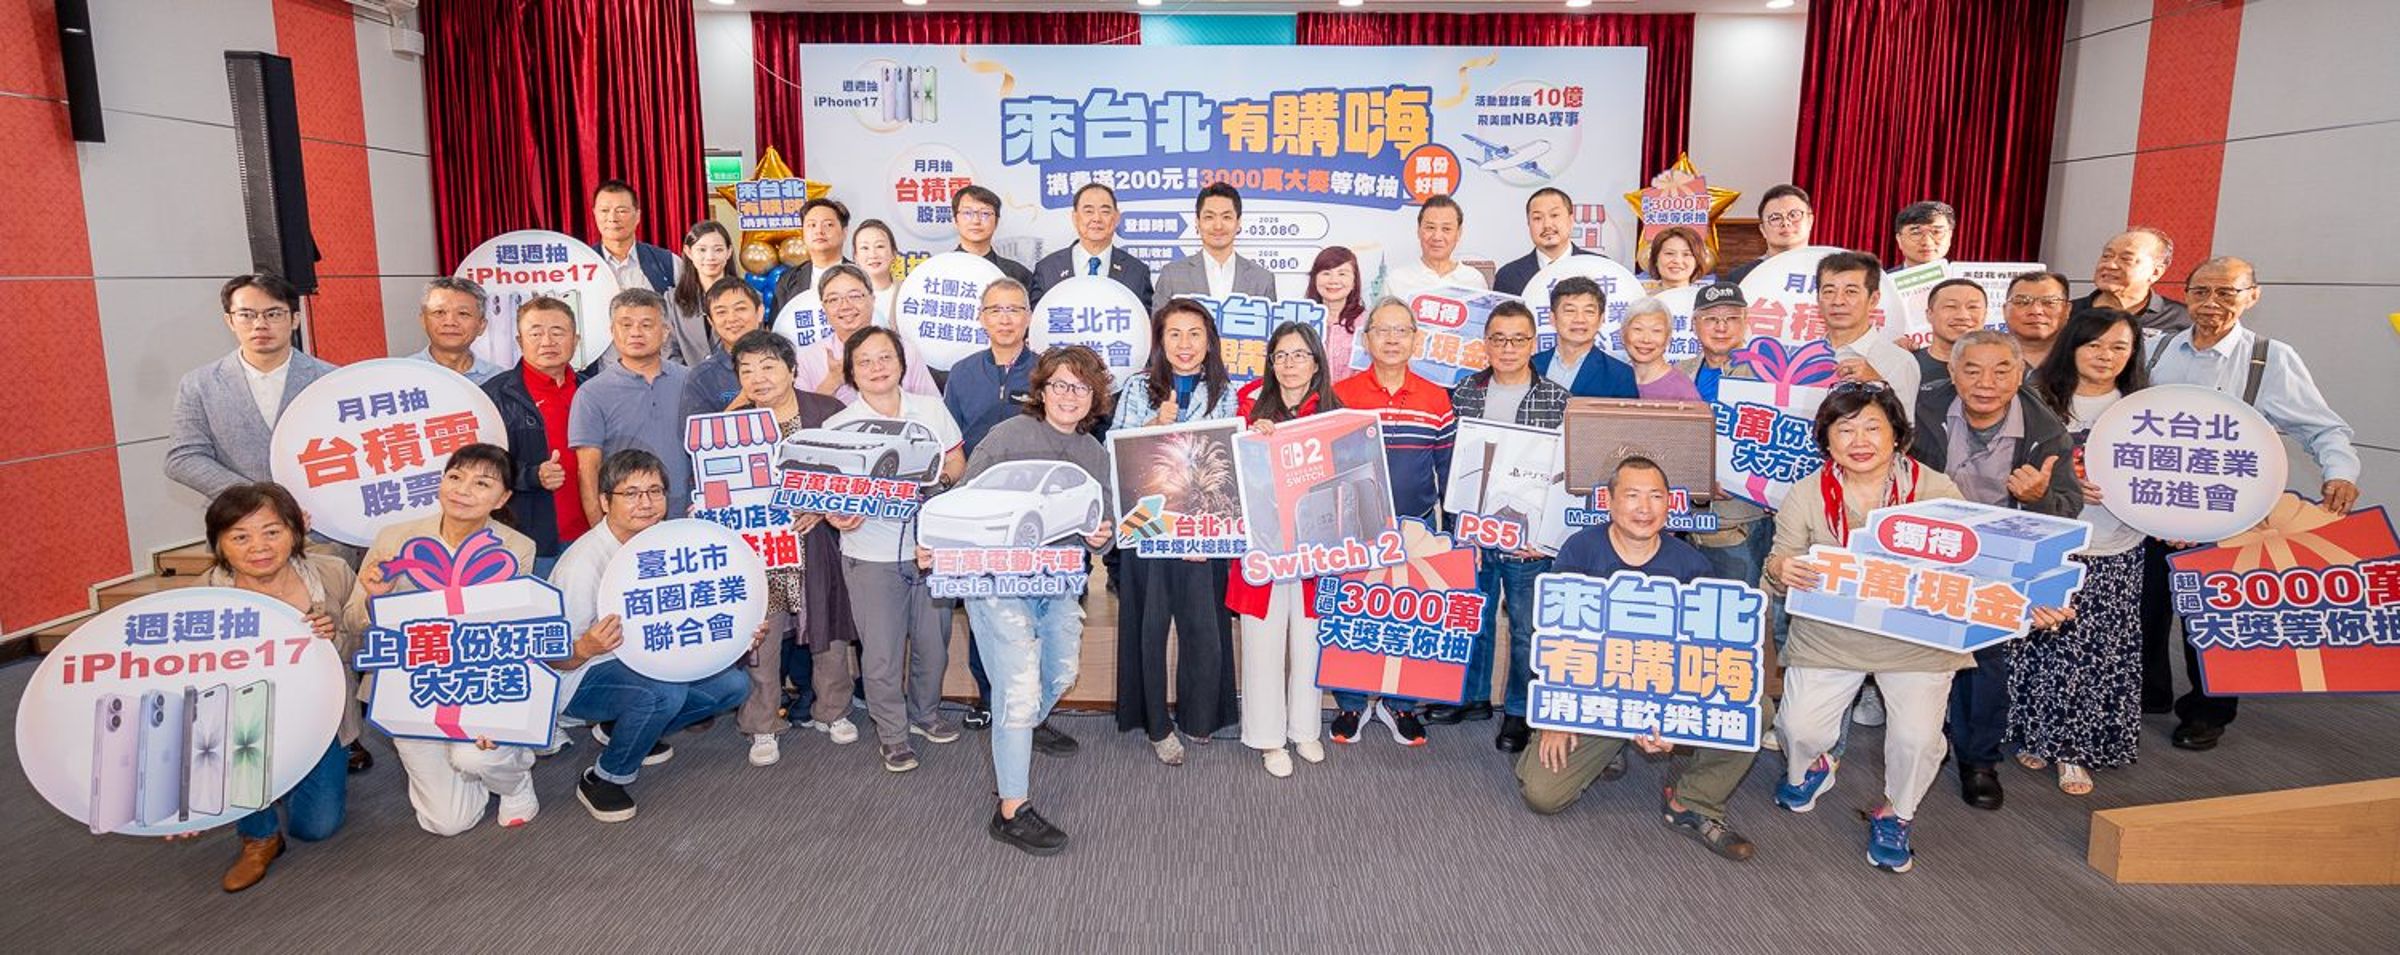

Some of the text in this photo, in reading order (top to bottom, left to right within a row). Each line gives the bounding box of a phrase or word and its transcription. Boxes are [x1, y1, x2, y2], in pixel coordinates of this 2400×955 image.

[813, 95, 879, 108] iPhone17
[914, 159, 953, 173] 月月抽
[738, 180, 804, 199] 來台北
[916, 205, 954, 225] 股票
[496, 243, 569, 265] 週週抽
[467, 264, 598, 285] iPhone17
[923, 276, 979, 300] 社團法
[902, 296, 982, 321] 台灣連鎖
[1047, 306, 1132, 334] 臺北市
[337, 387, 430, 423] 月月抽
[2131, 409, 2240, 442] 大台北
[297, 410, 480, 489] 台積電
[2112, 442, 2259, 479] 商圈產業
[360, 470, 442, 518] 股票
[782, 471, 919, 500] 百萬電動汽車
[2128, 476, 2239, 513] 協進會
[774, 490, 918, 519] LUXGEN n7
[1458, 514, 1522, 549] PS5
[1892, 520, 1964, 558] 獨得
[635, 543, 729, 580] 臺北市
[934, 549, 1083, 574] 百萬電動汽車
[1246, 534, 1403, 581] Switch 2
[623, 575, 749, 620] 商圈產業
[930, 576, 1087, 596] Tesla Model Y
[1815, 550, 2030, 631] 千萬現金
[2206, 562, 2400, 609] 3000萬
[124, 606, 260, 647] 週週抽
[1340, 584, 1485, 633] 3000萬
[1541, 579, 1758, 643] 來台北
[359, 622, 570, 669] 上萬份好禮
[642, 613, 735, 653] 聯合會
[1319, 617, 1472, 662] 大獎等你抽
[2192, 609, 2400, 647] 大獎等你抽
[62, 637, 312, 685] iPhone17
[1539, 638, 1754, 702] 有購嗨
[414, 664, 530, 704] 大方送
[1538, 690, 1748, 742] 消費歡樂抽
